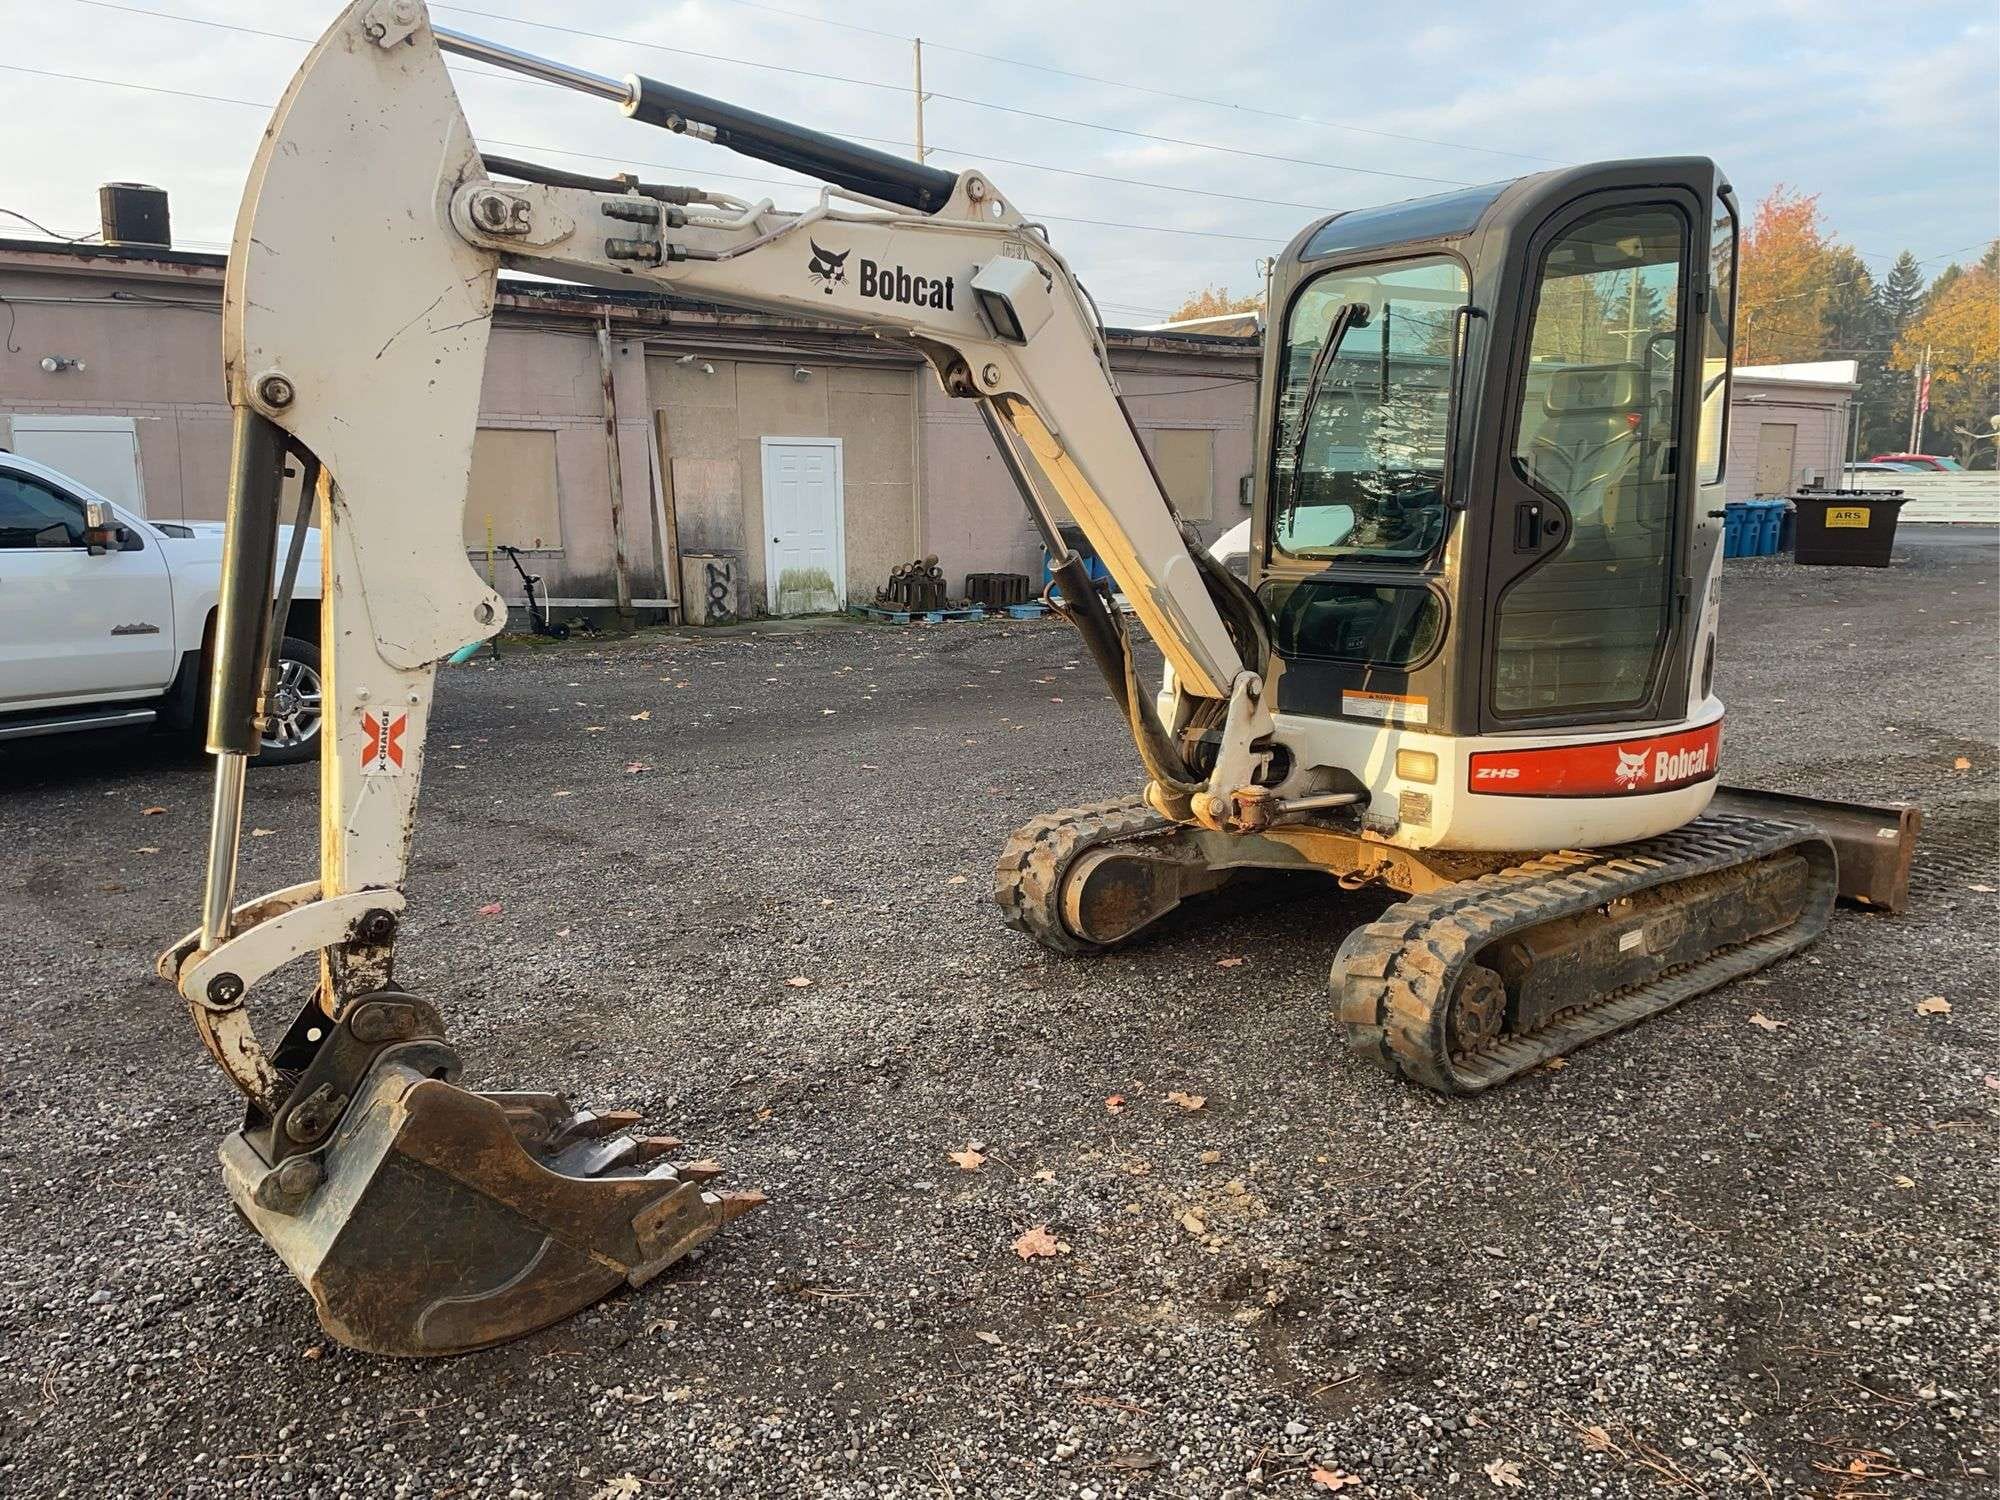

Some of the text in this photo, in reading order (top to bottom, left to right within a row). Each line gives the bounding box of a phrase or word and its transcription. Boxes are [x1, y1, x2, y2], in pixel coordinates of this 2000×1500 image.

[859, 258, 954, 312] Bobcat
[1835, 511, 1861, 519] ARS
[379, 710, 390, 772] X-CHANGE
[1475, 768, 1521, 779] ZHS
[1653, 742, 1709, 783] Bobcat
